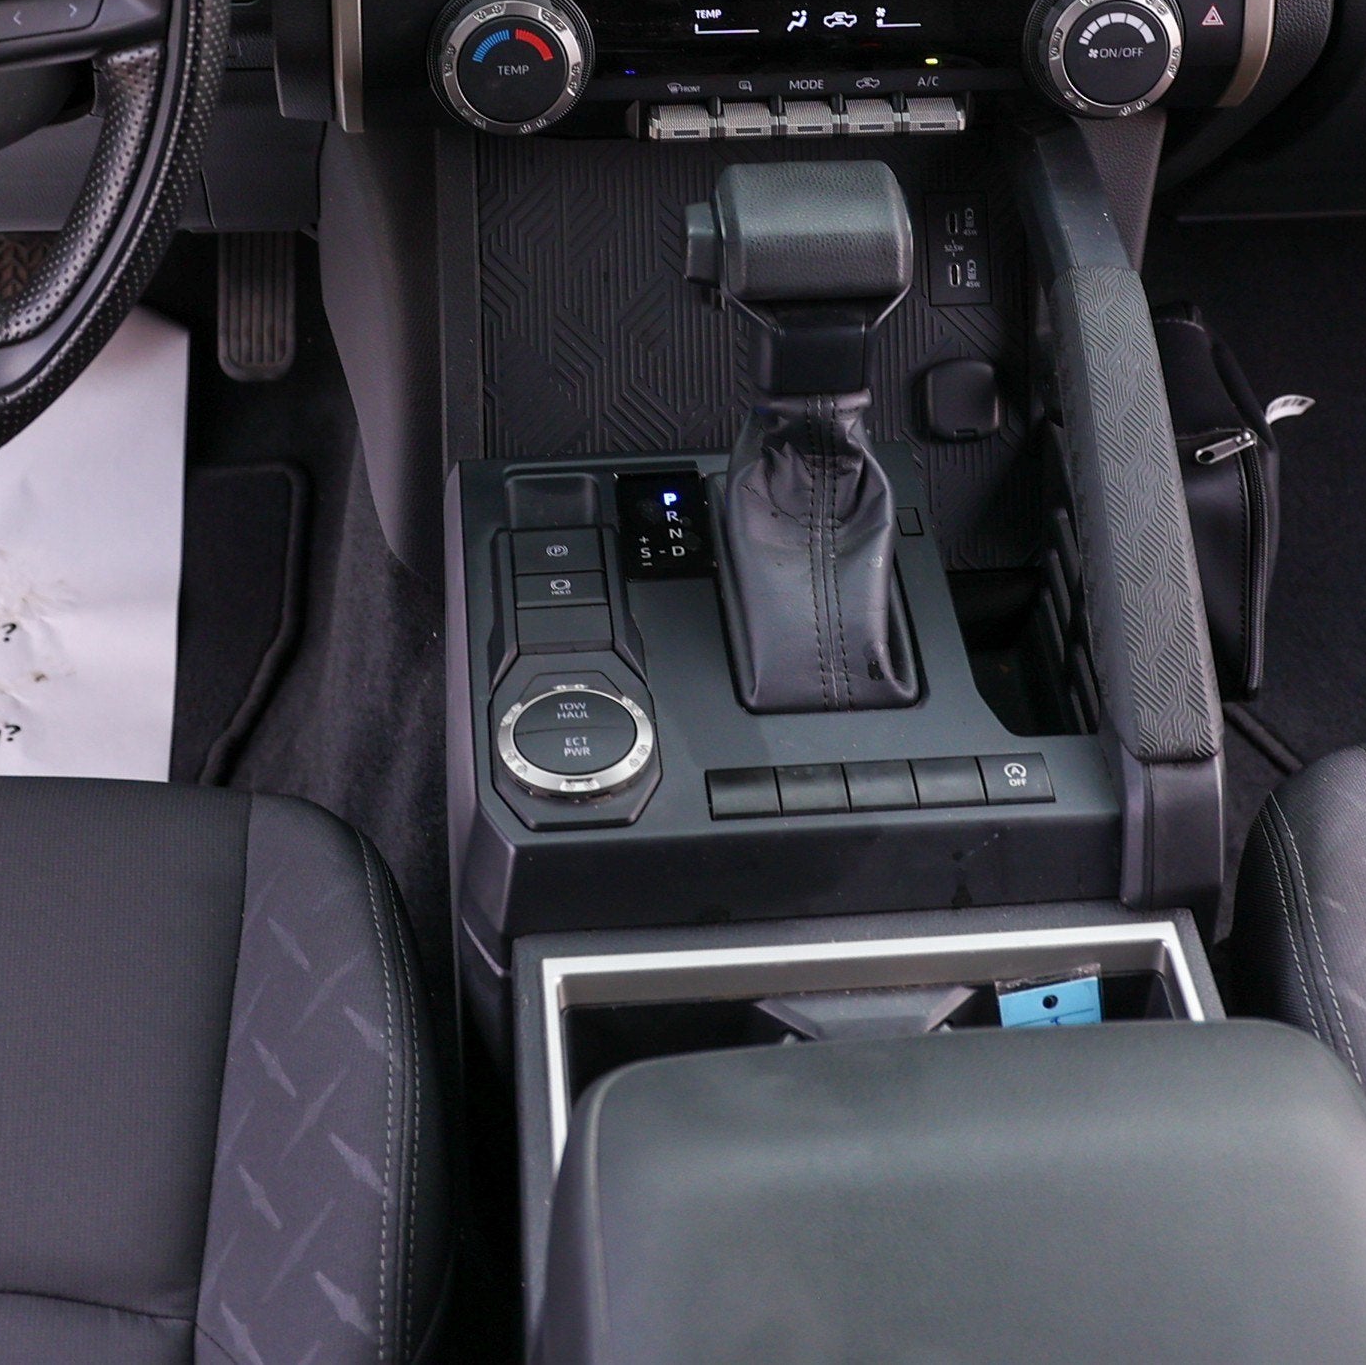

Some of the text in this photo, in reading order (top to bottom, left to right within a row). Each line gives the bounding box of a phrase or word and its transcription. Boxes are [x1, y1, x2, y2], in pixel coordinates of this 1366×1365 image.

[695, 9, 722, 20] TEMP
[1100, 46, 1144, 59] ON/OFF
[497, 64, 530, 76] TEMP
[789, 80, 824, 90] MODE
[917, 75, 939, 87] A/C
[663, 492, 678, 506] P
[666, 510, 680, 522] R
[669, 528, 683, 539] N
[640, 546, 686, 559] S D
[558, 702, 587, 711] TOW
[556, 711, 590, 720] HAUL
[565, 737, 588, 747] ECT
[564, 747, 591, 757] PWR
[1008, 778, 1027, 787] OFF
